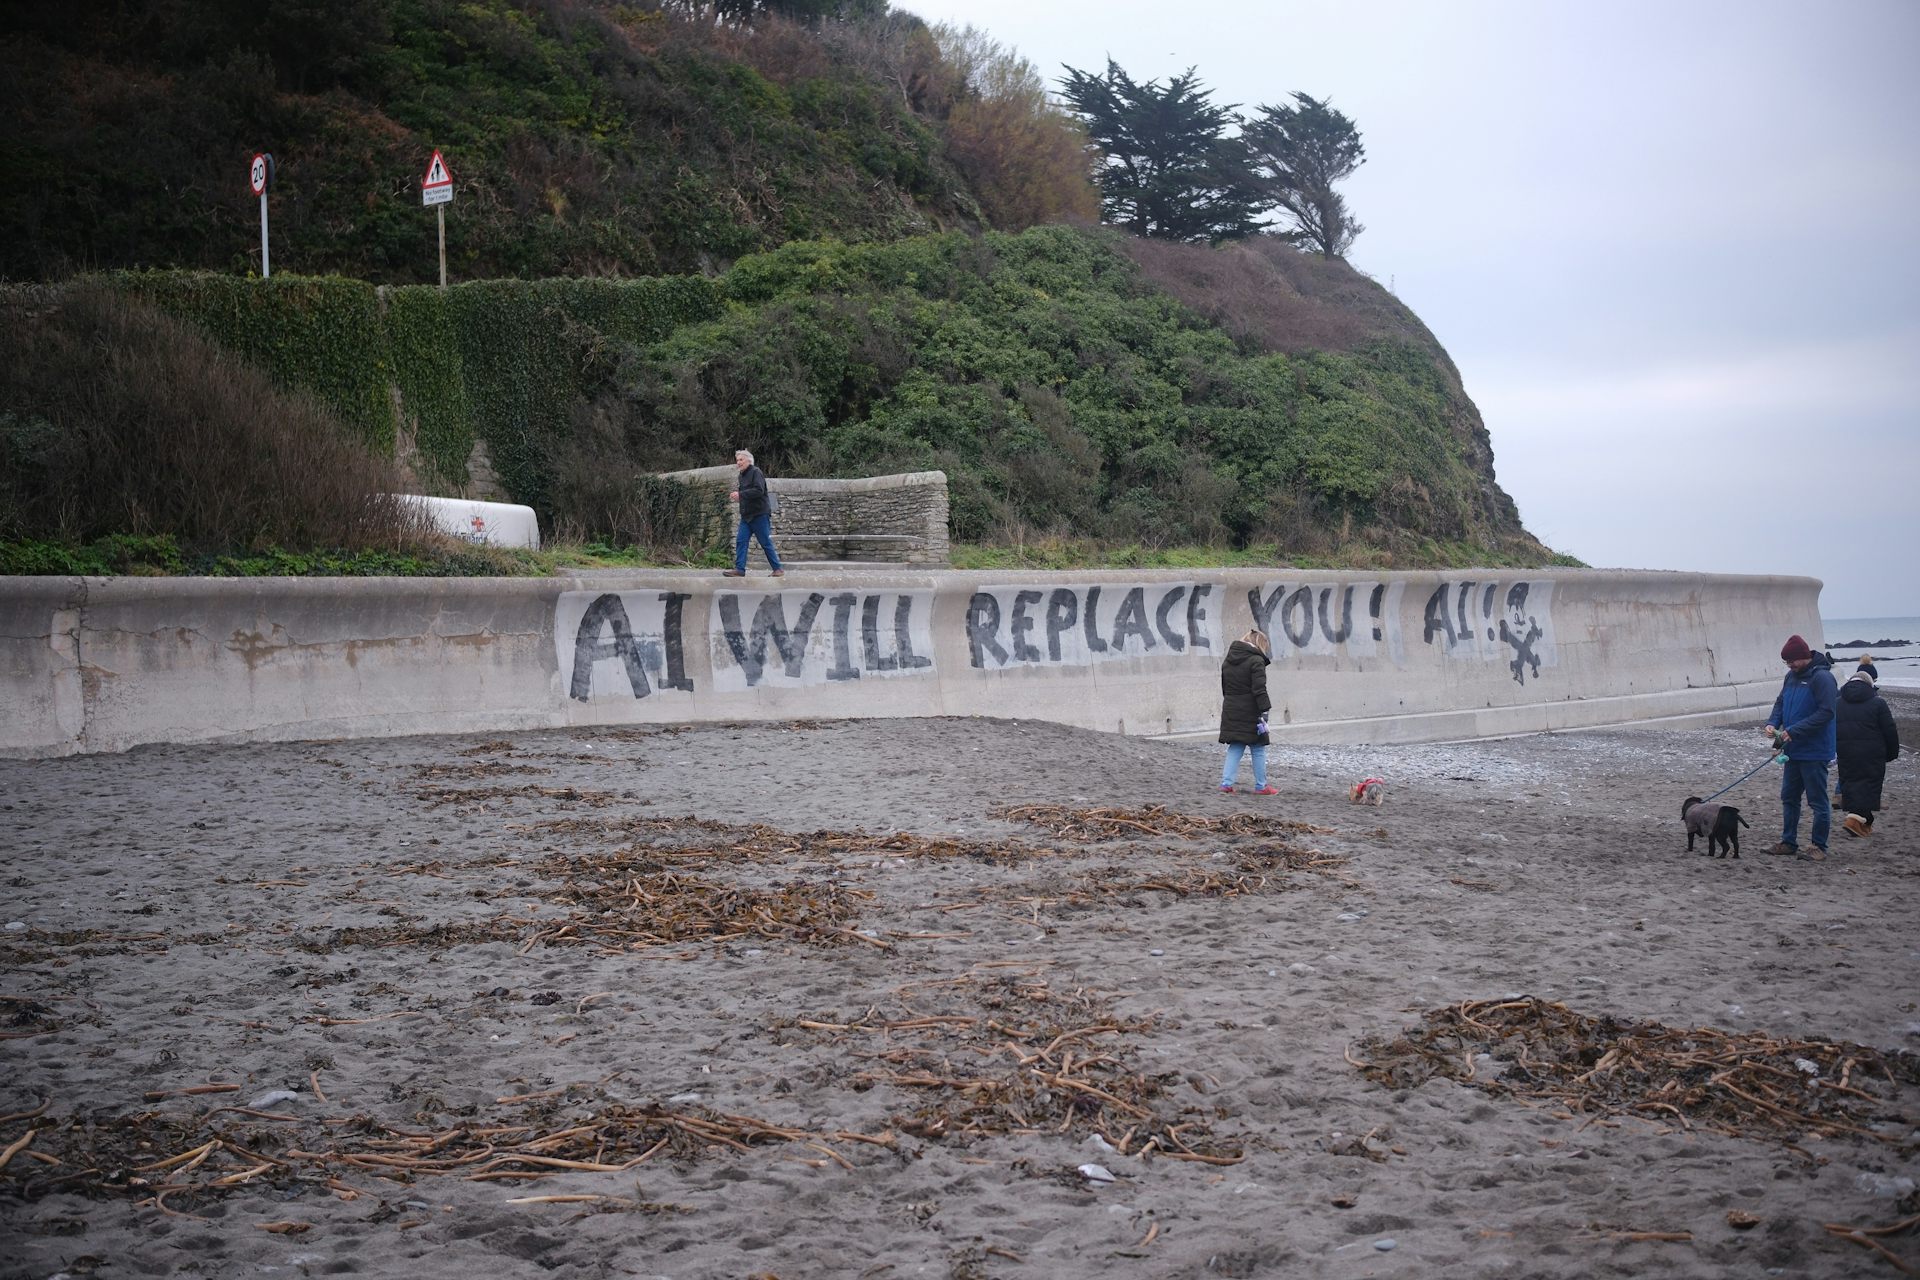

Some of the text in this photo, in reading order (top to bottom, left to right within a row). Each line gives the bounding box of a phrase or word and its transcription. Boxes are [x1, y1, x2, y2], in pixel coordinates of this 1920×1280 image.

[253, 164, 264, 184] 20
[570, 581, 1497, 702] AI WILL REPLACE YOU! AI!
